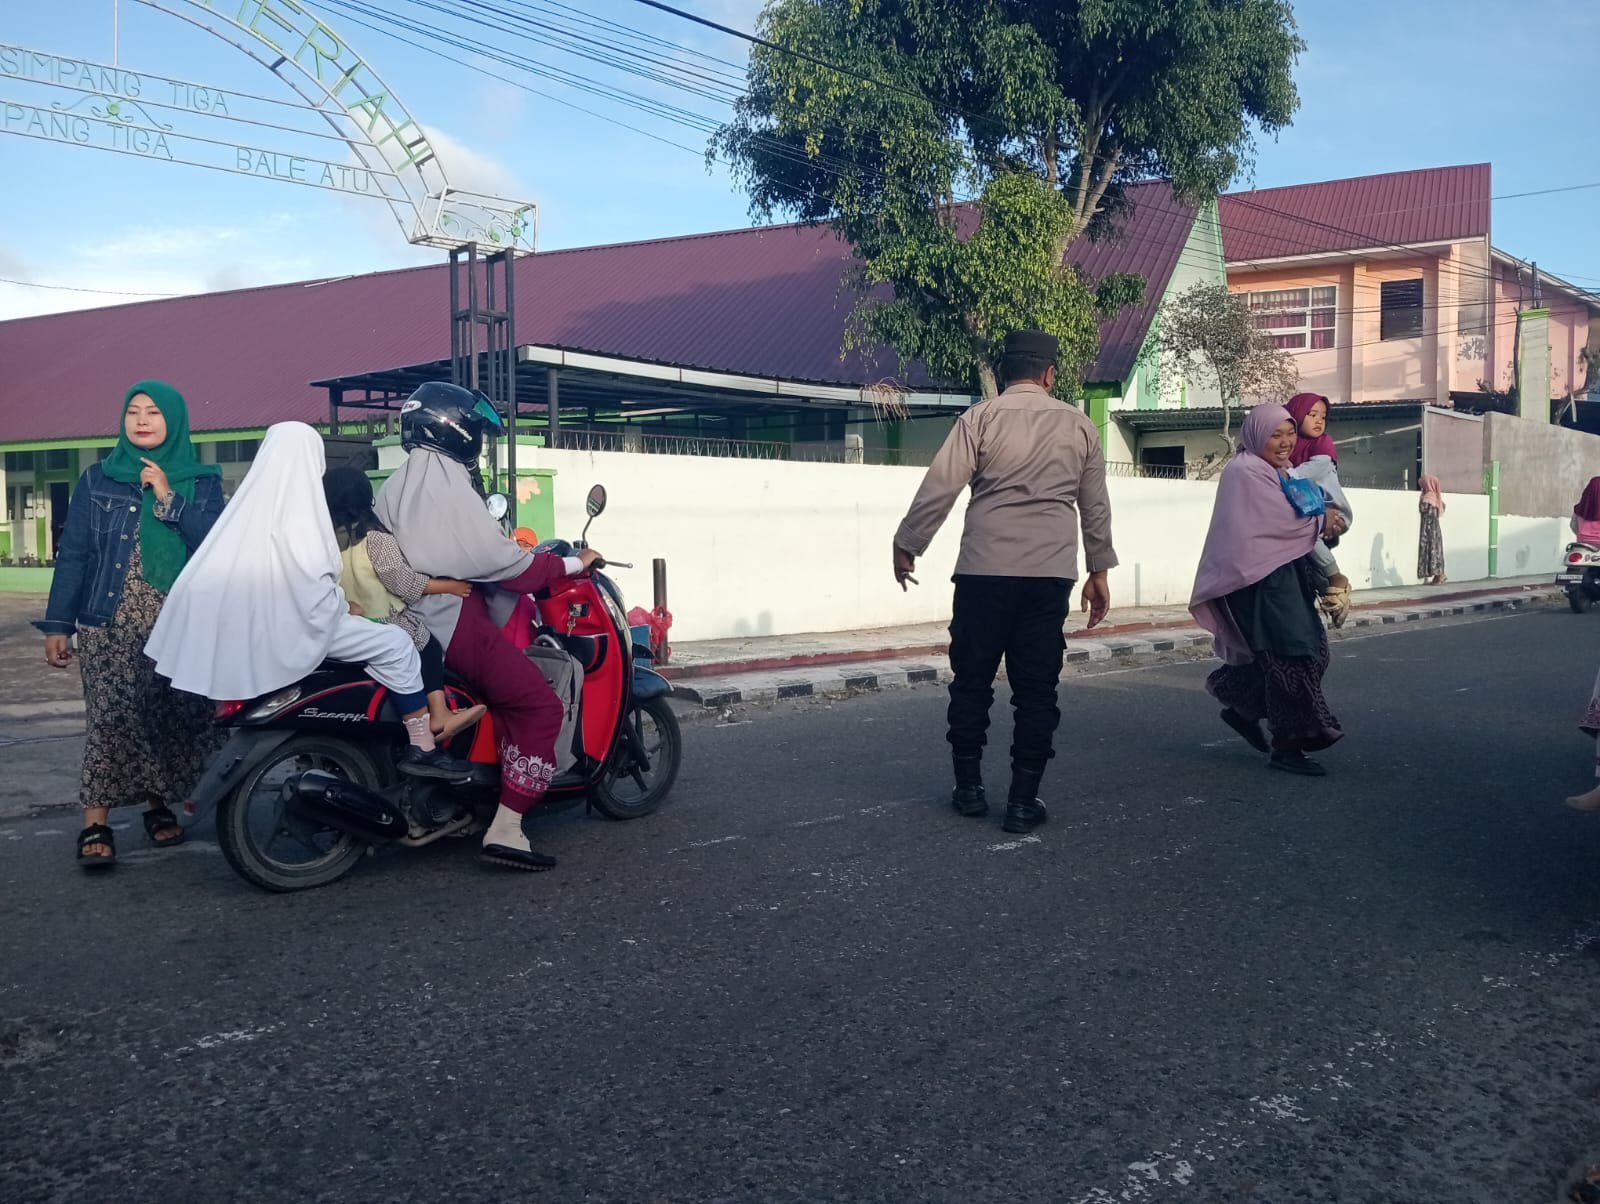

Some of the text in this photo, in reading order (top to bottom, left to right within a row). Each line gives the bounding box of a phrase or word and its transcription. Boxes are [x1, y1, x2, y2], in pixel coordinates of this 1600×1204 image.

[0, 48, 229, 115] SIMPANG TIGA
[203, 0, 433, 173] ERIAH
[236, 147, 306, 181] BALE
[320, 163, 369, 192] ATU
[297, 707, 369, 722] Scoopy
